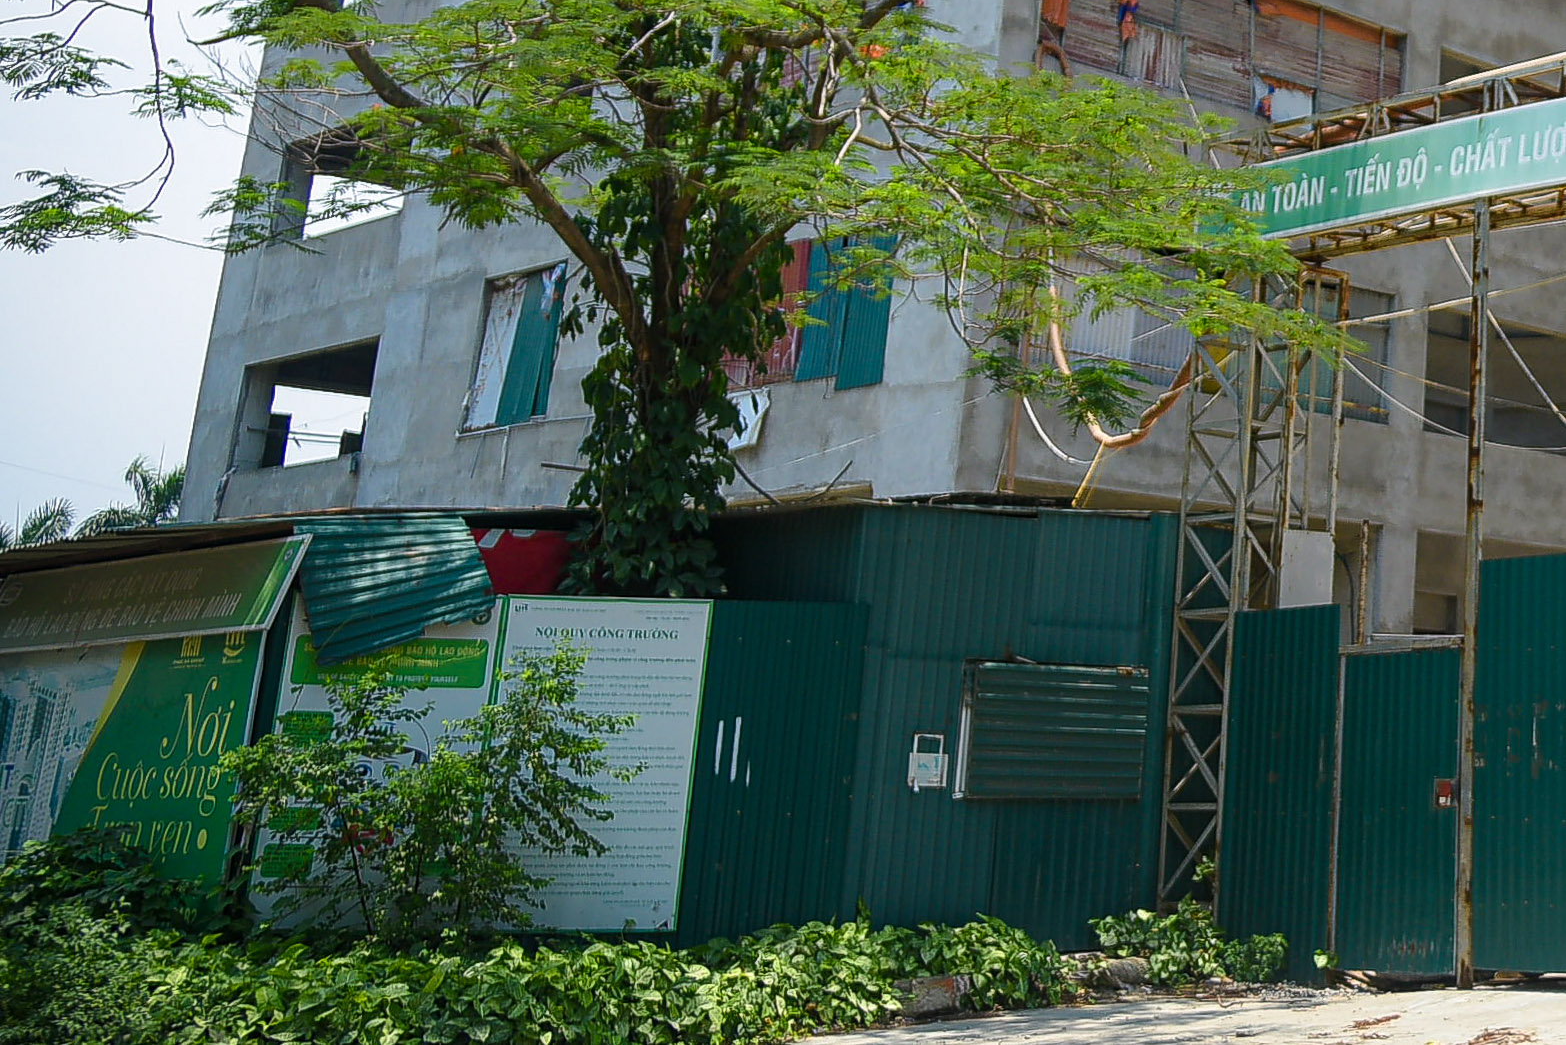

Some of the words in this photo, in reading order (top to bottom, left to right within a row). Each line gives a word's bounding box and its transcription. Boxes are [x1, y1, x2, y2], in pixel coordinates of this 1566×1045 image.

[1272, 171, 1326, 213] TOÀN
[1345, 152, 1391, 198] TIẾN
[1396, 147, 1428, 190] ĐỘ
[1449, 126, 1514, 176] CHẤT
[589, 625, 625, 640] CÔNG
[627, 627, 679, 640] TRƯỜNG
[159, 676, 235, 759] Nơi
[97, 752, 157, 808] Cuộc
[159, 756, 223, 817] sống
